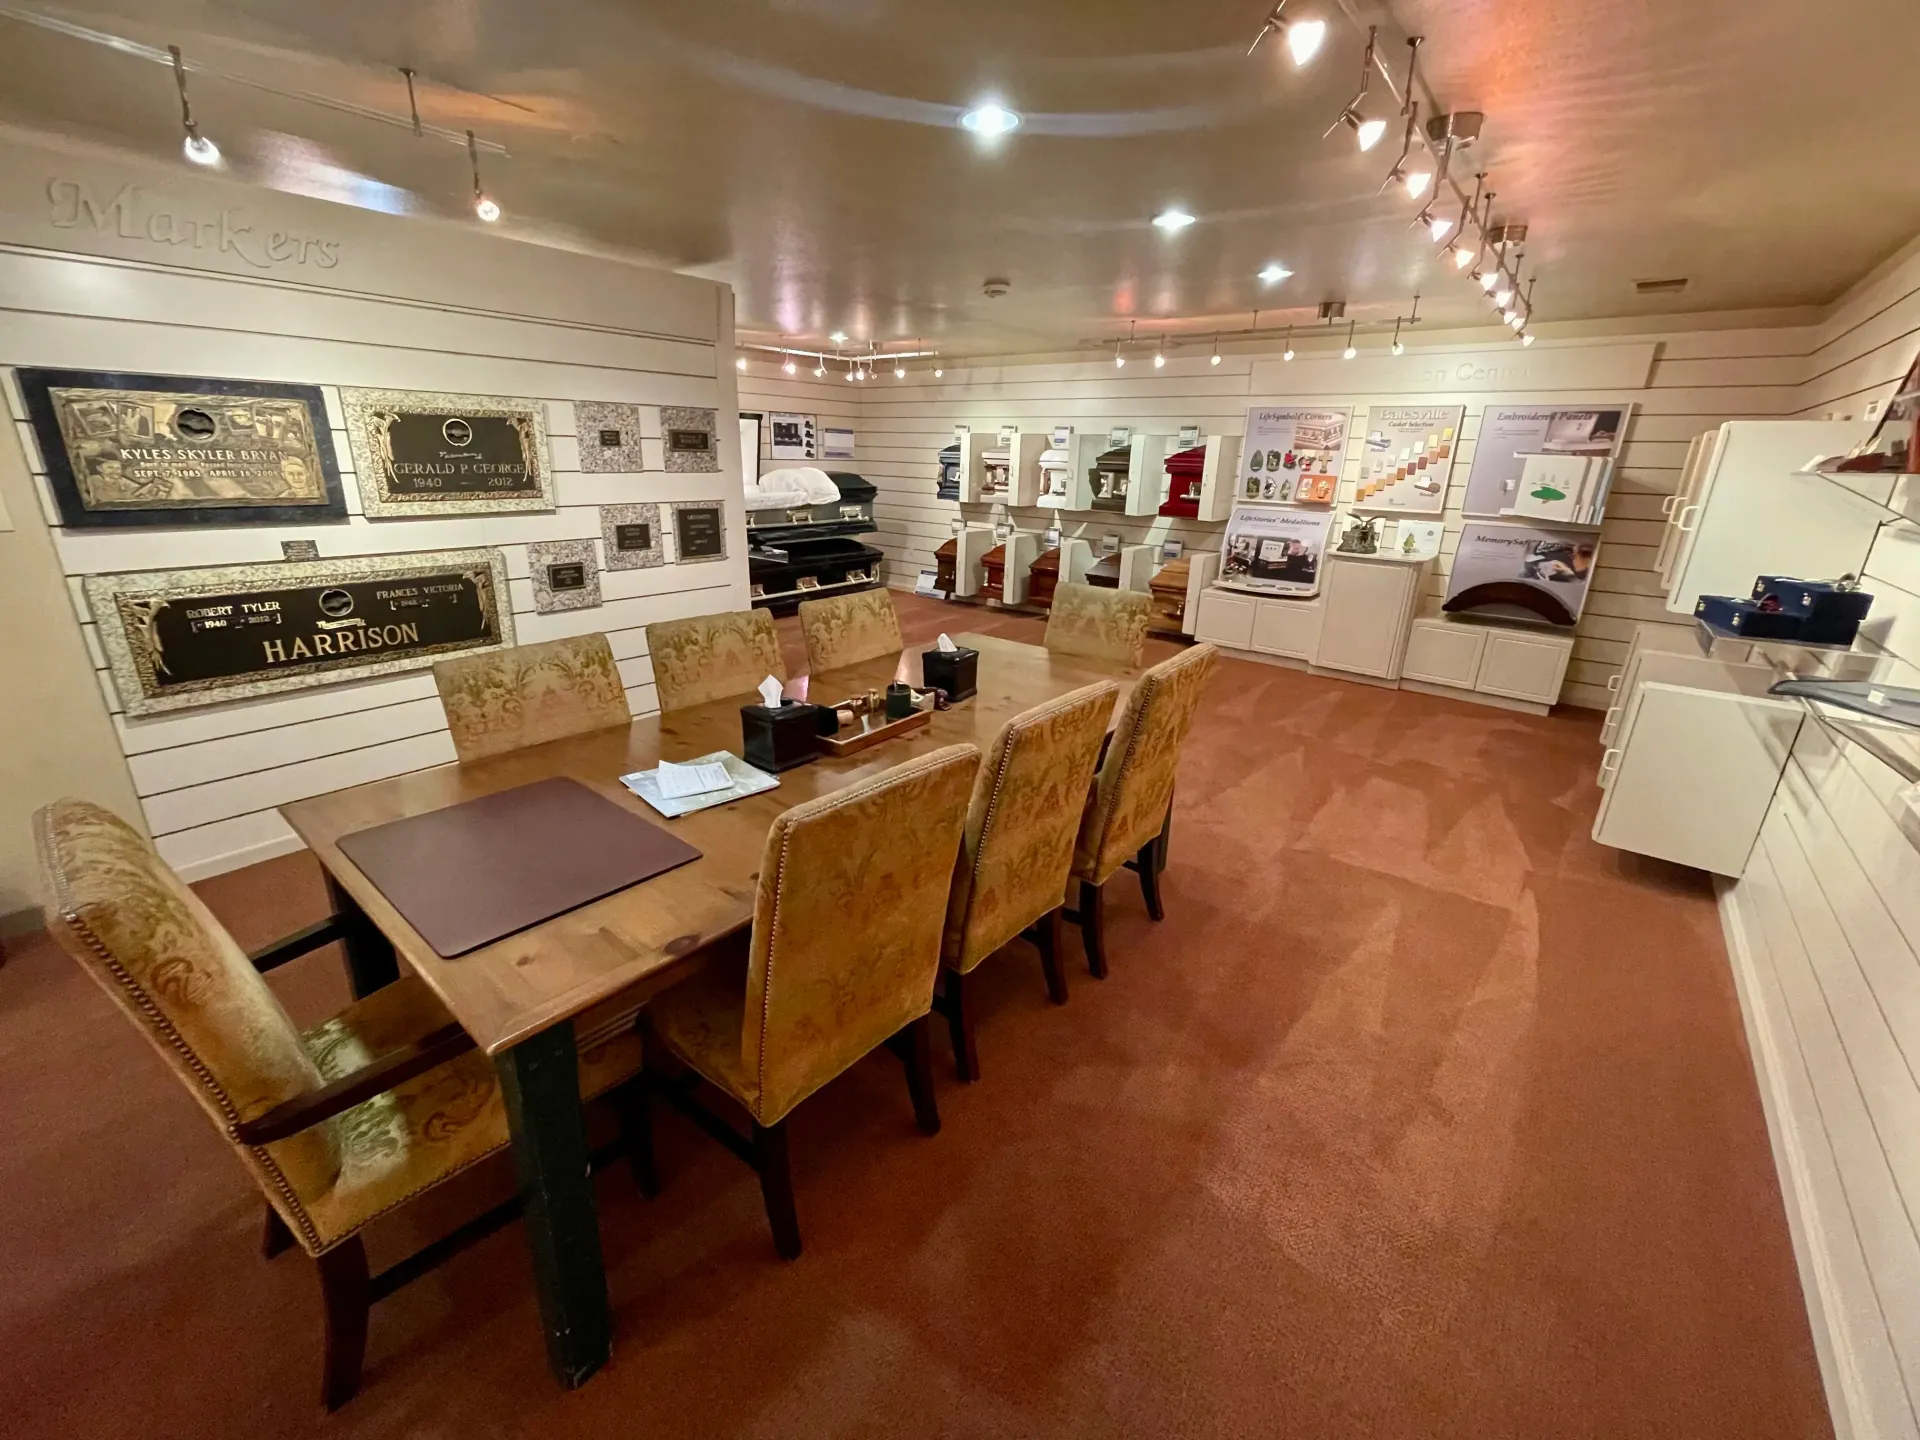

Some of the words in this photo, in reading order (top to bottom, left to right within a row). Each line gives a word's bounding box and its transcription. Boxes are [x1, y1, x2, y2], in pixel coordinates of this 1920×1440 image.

[45, 176, 341, 269] Markers
[1305, 412, 1333, 421] Corners
[1497, 411, 1556, 421] Embroidered
[1558, 411, 1593, 421] Panels
[120, 448, 171, 460] KYLES
[178, 448, 235, 460] SKYLER
[241, 449, 289, 461] BRYAN
[209, 469, 237, 477] APRIL
[393, 462, 455, 474] GERALD
[473, 463, 526, 474] GEORGE
[413, 477, 442, 488] 1940
[487, 477, 514, 487] 2012
[1280, 517, 1321, 527] Medallions
[376, 587, 418, 600] FRANCES
[423, 583, 464, 594] VICTORIA
[185, 605, 234, 619] ROBERT
[241, 601, 282, 613] TYLER
[204, 619, 227, 629] 1940
[247, 615, 271, 624] 2012
[262, 622, 420, 664] HARRISON
